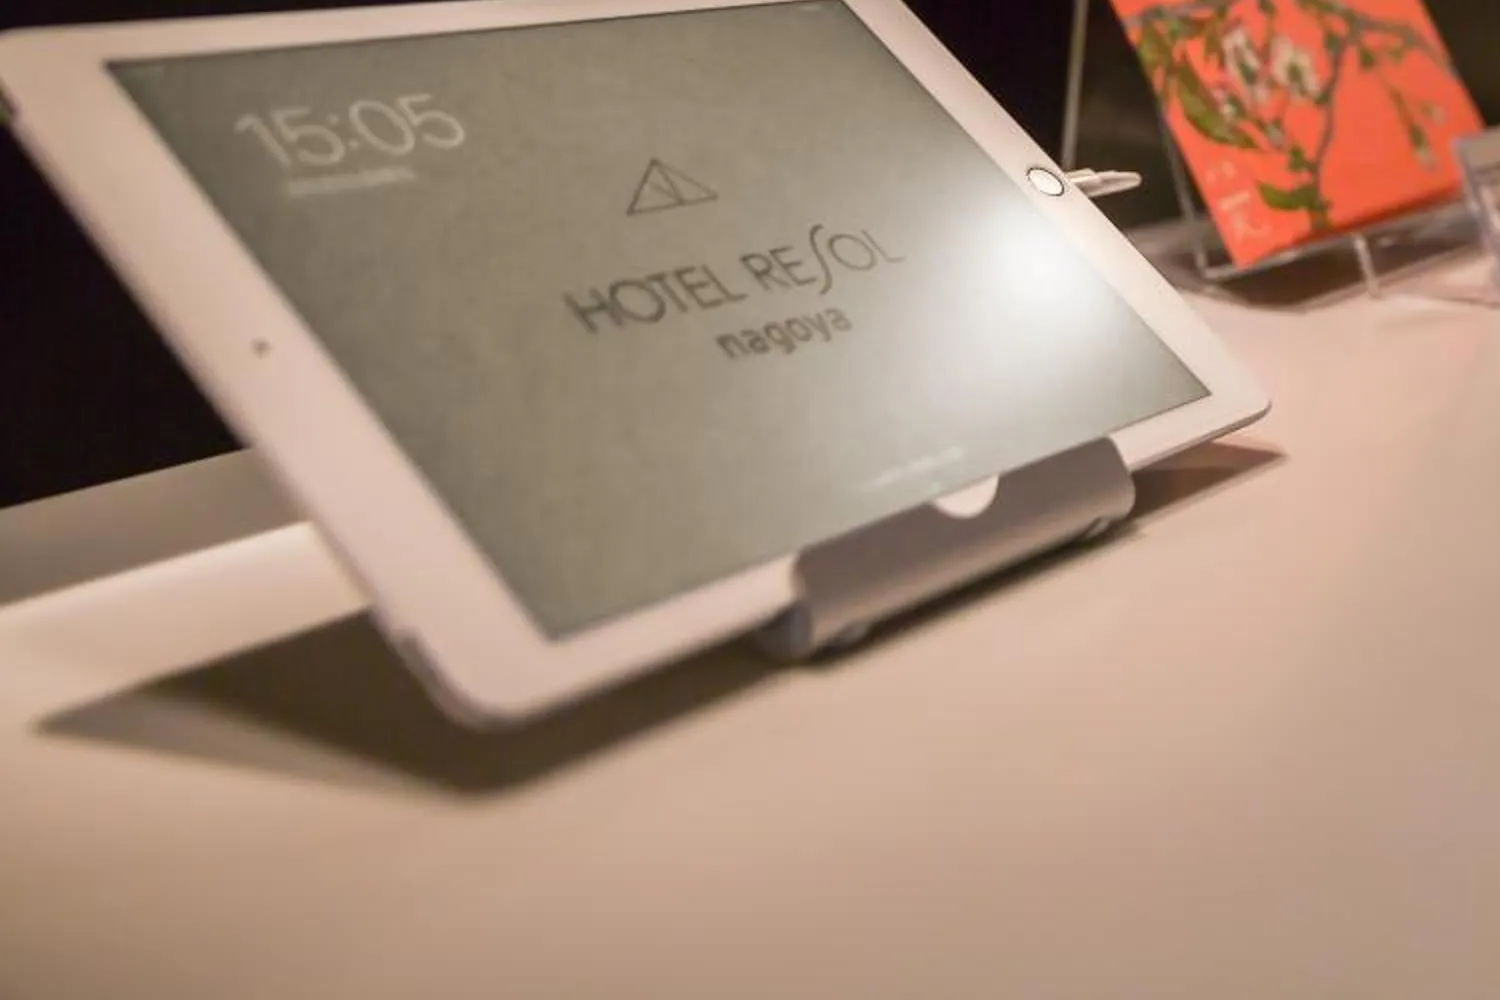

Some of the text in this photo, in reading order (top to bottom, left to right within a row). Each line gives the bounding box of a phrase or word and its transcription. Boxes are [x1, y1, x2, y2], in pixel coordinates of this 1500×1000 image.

[235, 94, 465, 166] 15:05
[564, 224, 906, 334] HOTEL RESOL
[716, 306, 854, 361] nagoya
